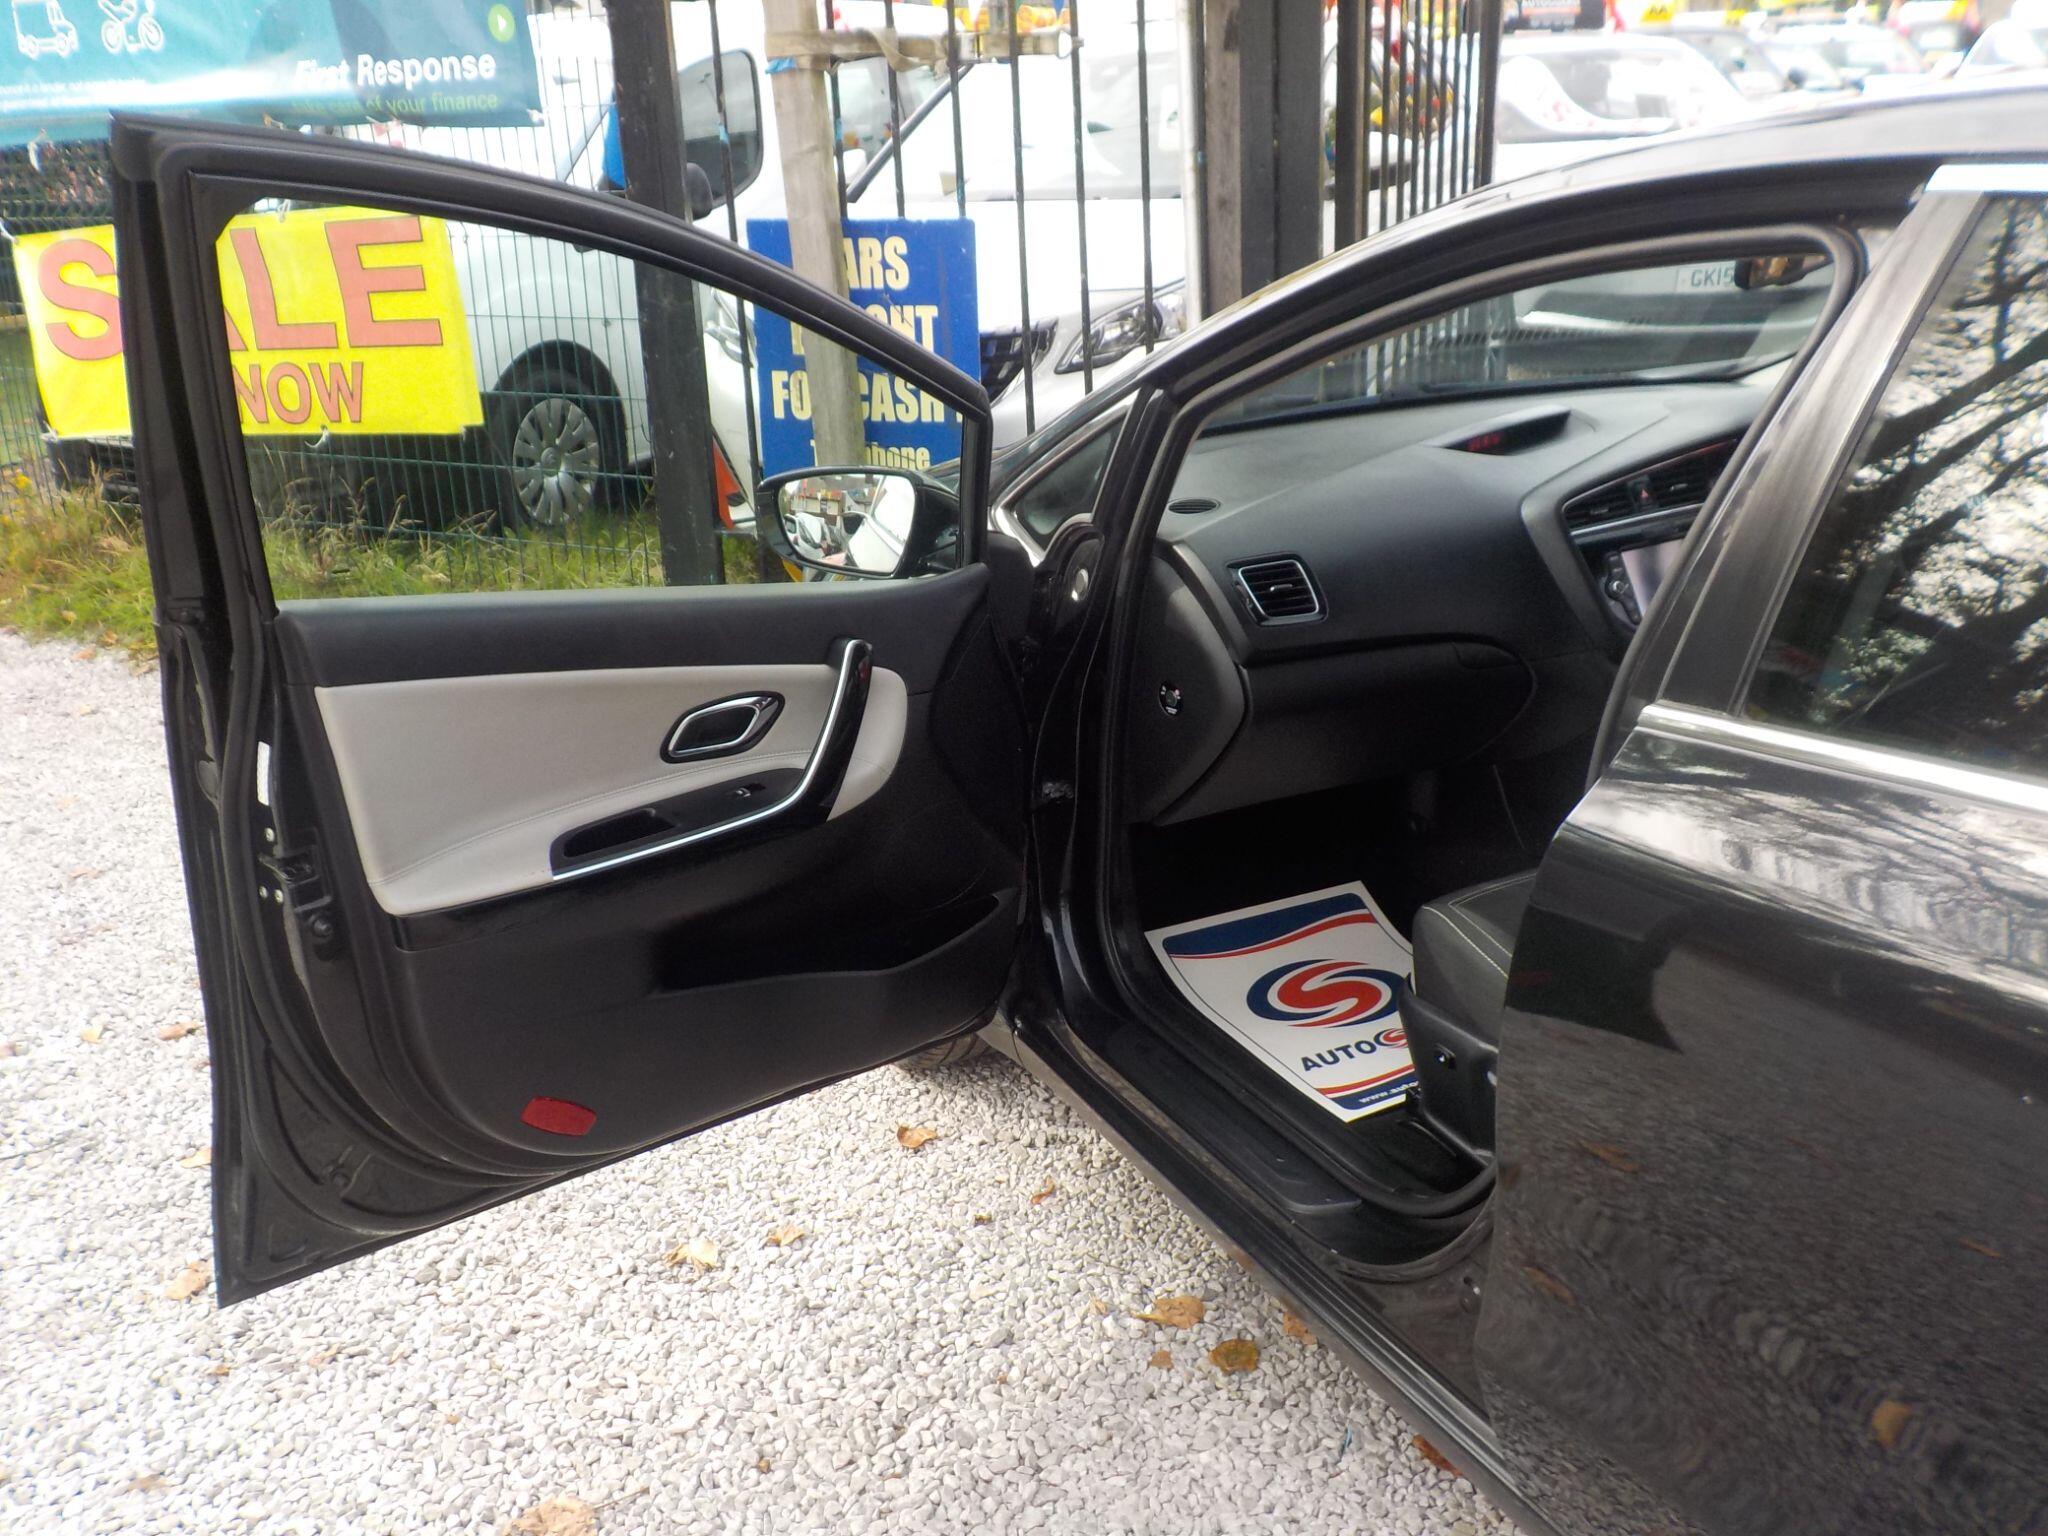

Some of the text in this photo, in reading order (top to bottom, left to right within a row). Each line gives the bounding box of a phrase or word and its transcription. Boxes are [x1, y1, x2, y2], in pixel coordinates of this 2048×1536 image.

[357, 53, 497, 91] Response
[387, 96, 428, 117] your
[431, 91, 500, 112] finance
[38, 214, 443, 361] SLE
[842, 236, 910, 290] ARS
[771, 370, 812, 420] FO
